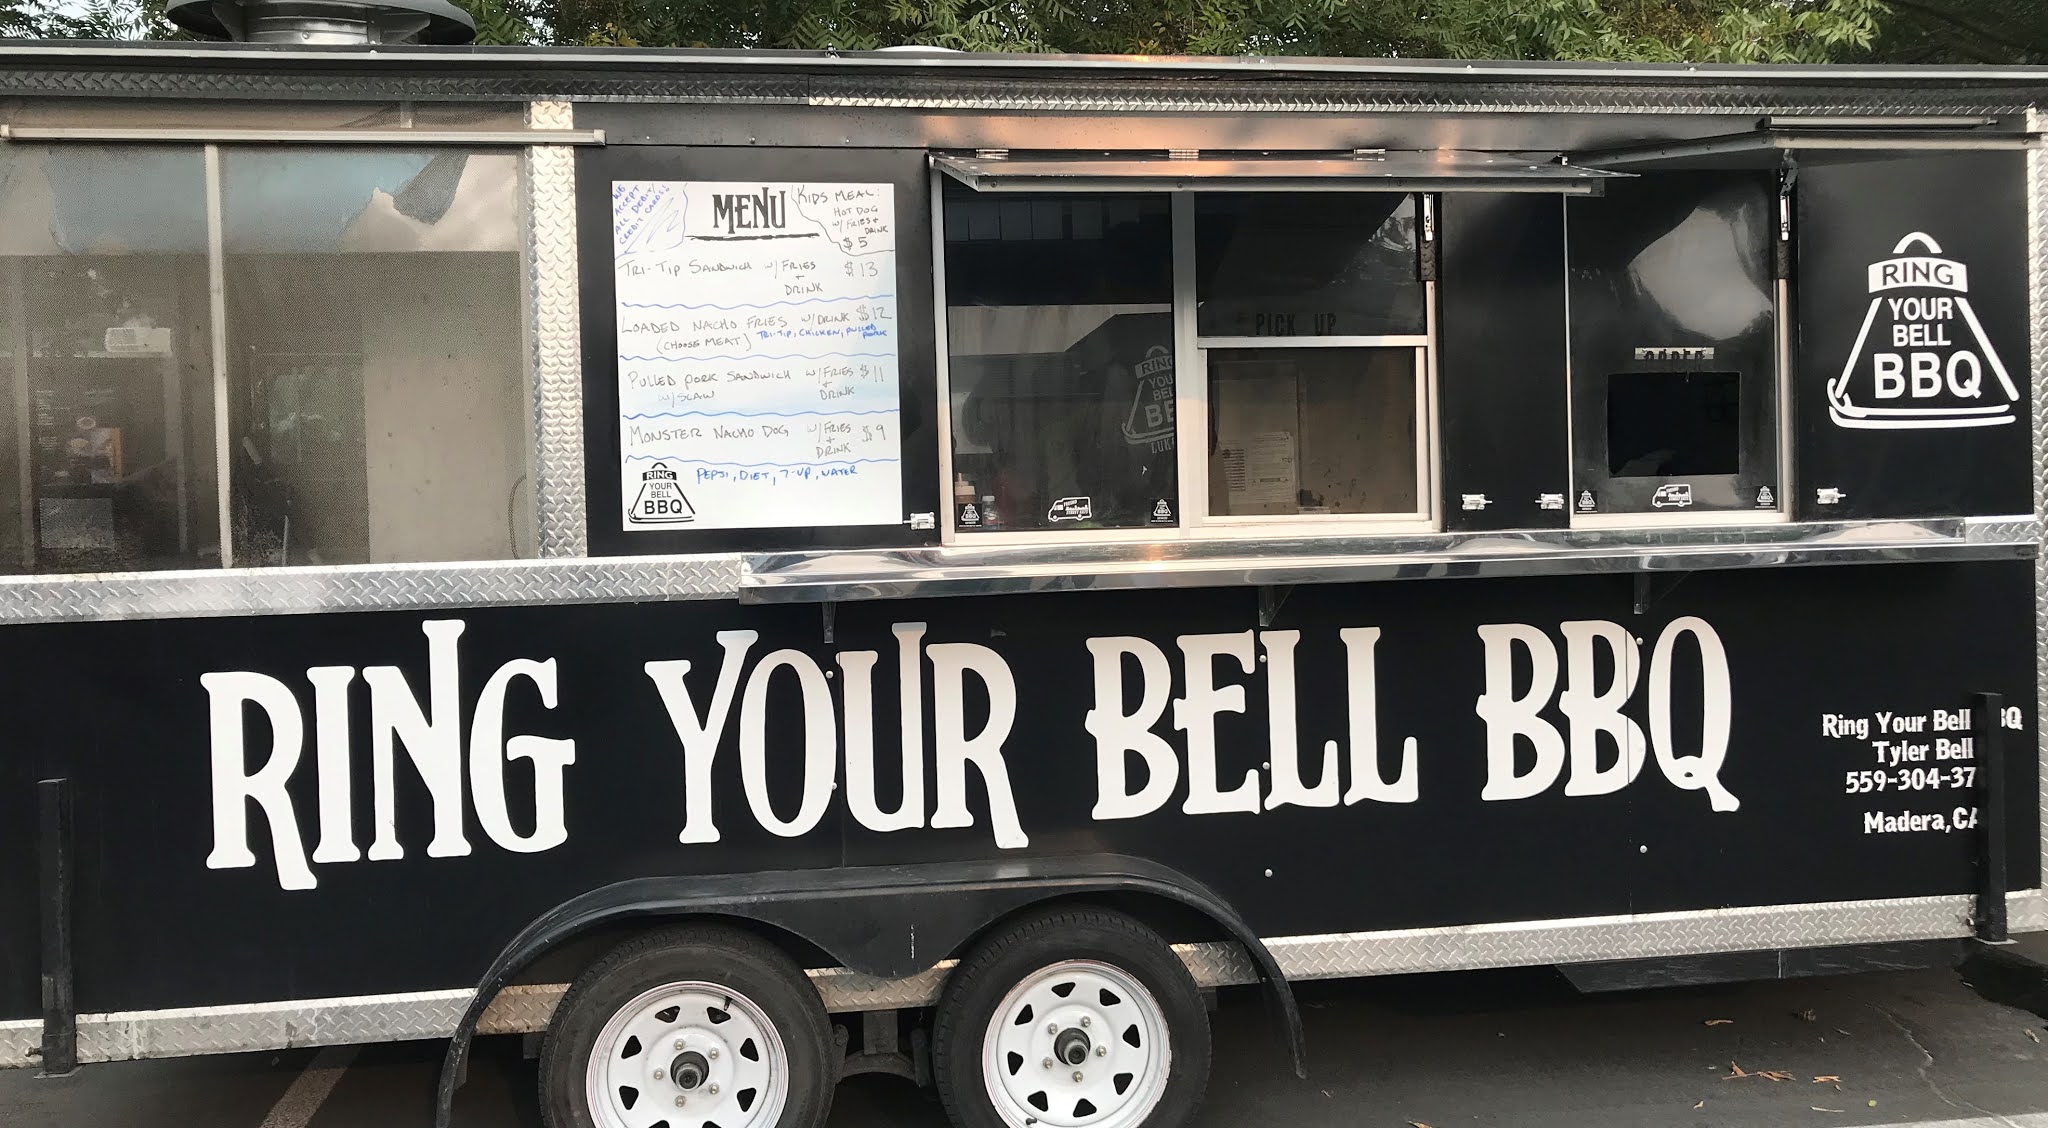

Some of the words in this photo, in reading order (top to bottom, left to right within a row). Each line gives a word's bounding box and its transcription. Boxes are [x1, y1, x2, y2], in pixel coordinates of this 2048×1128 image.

[615, 185, 640, 216] ACCEPT
[798, 185, 828, 205] KIDS
[712, 187, 786, 234] MENU
[834, 206, 852, 217] HOT
[856, 205, 878, 215] DOG
[619, 217, 644, 245] CREDIT
[864, 225, 888, 234] DRINK
[689, 259, 752, 274] SANDWICH
[1882, 262, 1954, 286] RING
[784, 282, 824, 295] DRINK
[1888, 297, 1953, 321] YOUR
[621, 315, 680, 333] LOADED
[693, 318, 737, 331] NACHO
[746, 315, 788, 328] FRIES
[1256, 312, 1297, 336] PICK
[1314, 312, 1337, 336] UP
[862, 330, 888, 340] PORK
[1892, 324, 1951, 347] BELL
[627, 371, 676, 389] PULLED
[727, 369, 792, 382] SANDWICH
[1149, 374, 1173, 388] YOU
[1874, 350, 1982, 399] BBQ
[820, 386, 855, 400] DRINK
[630, 425, 702, 446] MONSTER
[713, 425, 754, 439] NACHO
[762, 424, 789, 438] DOG
[816, 442, 851, 459] DRINK
[645, 470, 674, 480] RING
[649, 482, 673, 490] YOUR
[651, 490, 672, 498] BELL
[644, 500, 683, 514] BBQ
[1822, 714, 1869, 740] Ring
[1875, 711, 1927, 734] Your
[1933, 708, 1971, 731] Bell
[200, 619, 576, 891] RING
[644, 621, 1030, 850] YOUR
[1084, 628, 1418, 820] BELL
[1476, 615, 1740, 813] BBQ
[1872, 740, 1929, 767] Tyler
[1936, 737, 1974, 760] Bell
[1846, 767, 1976, 793] 559-304-37
